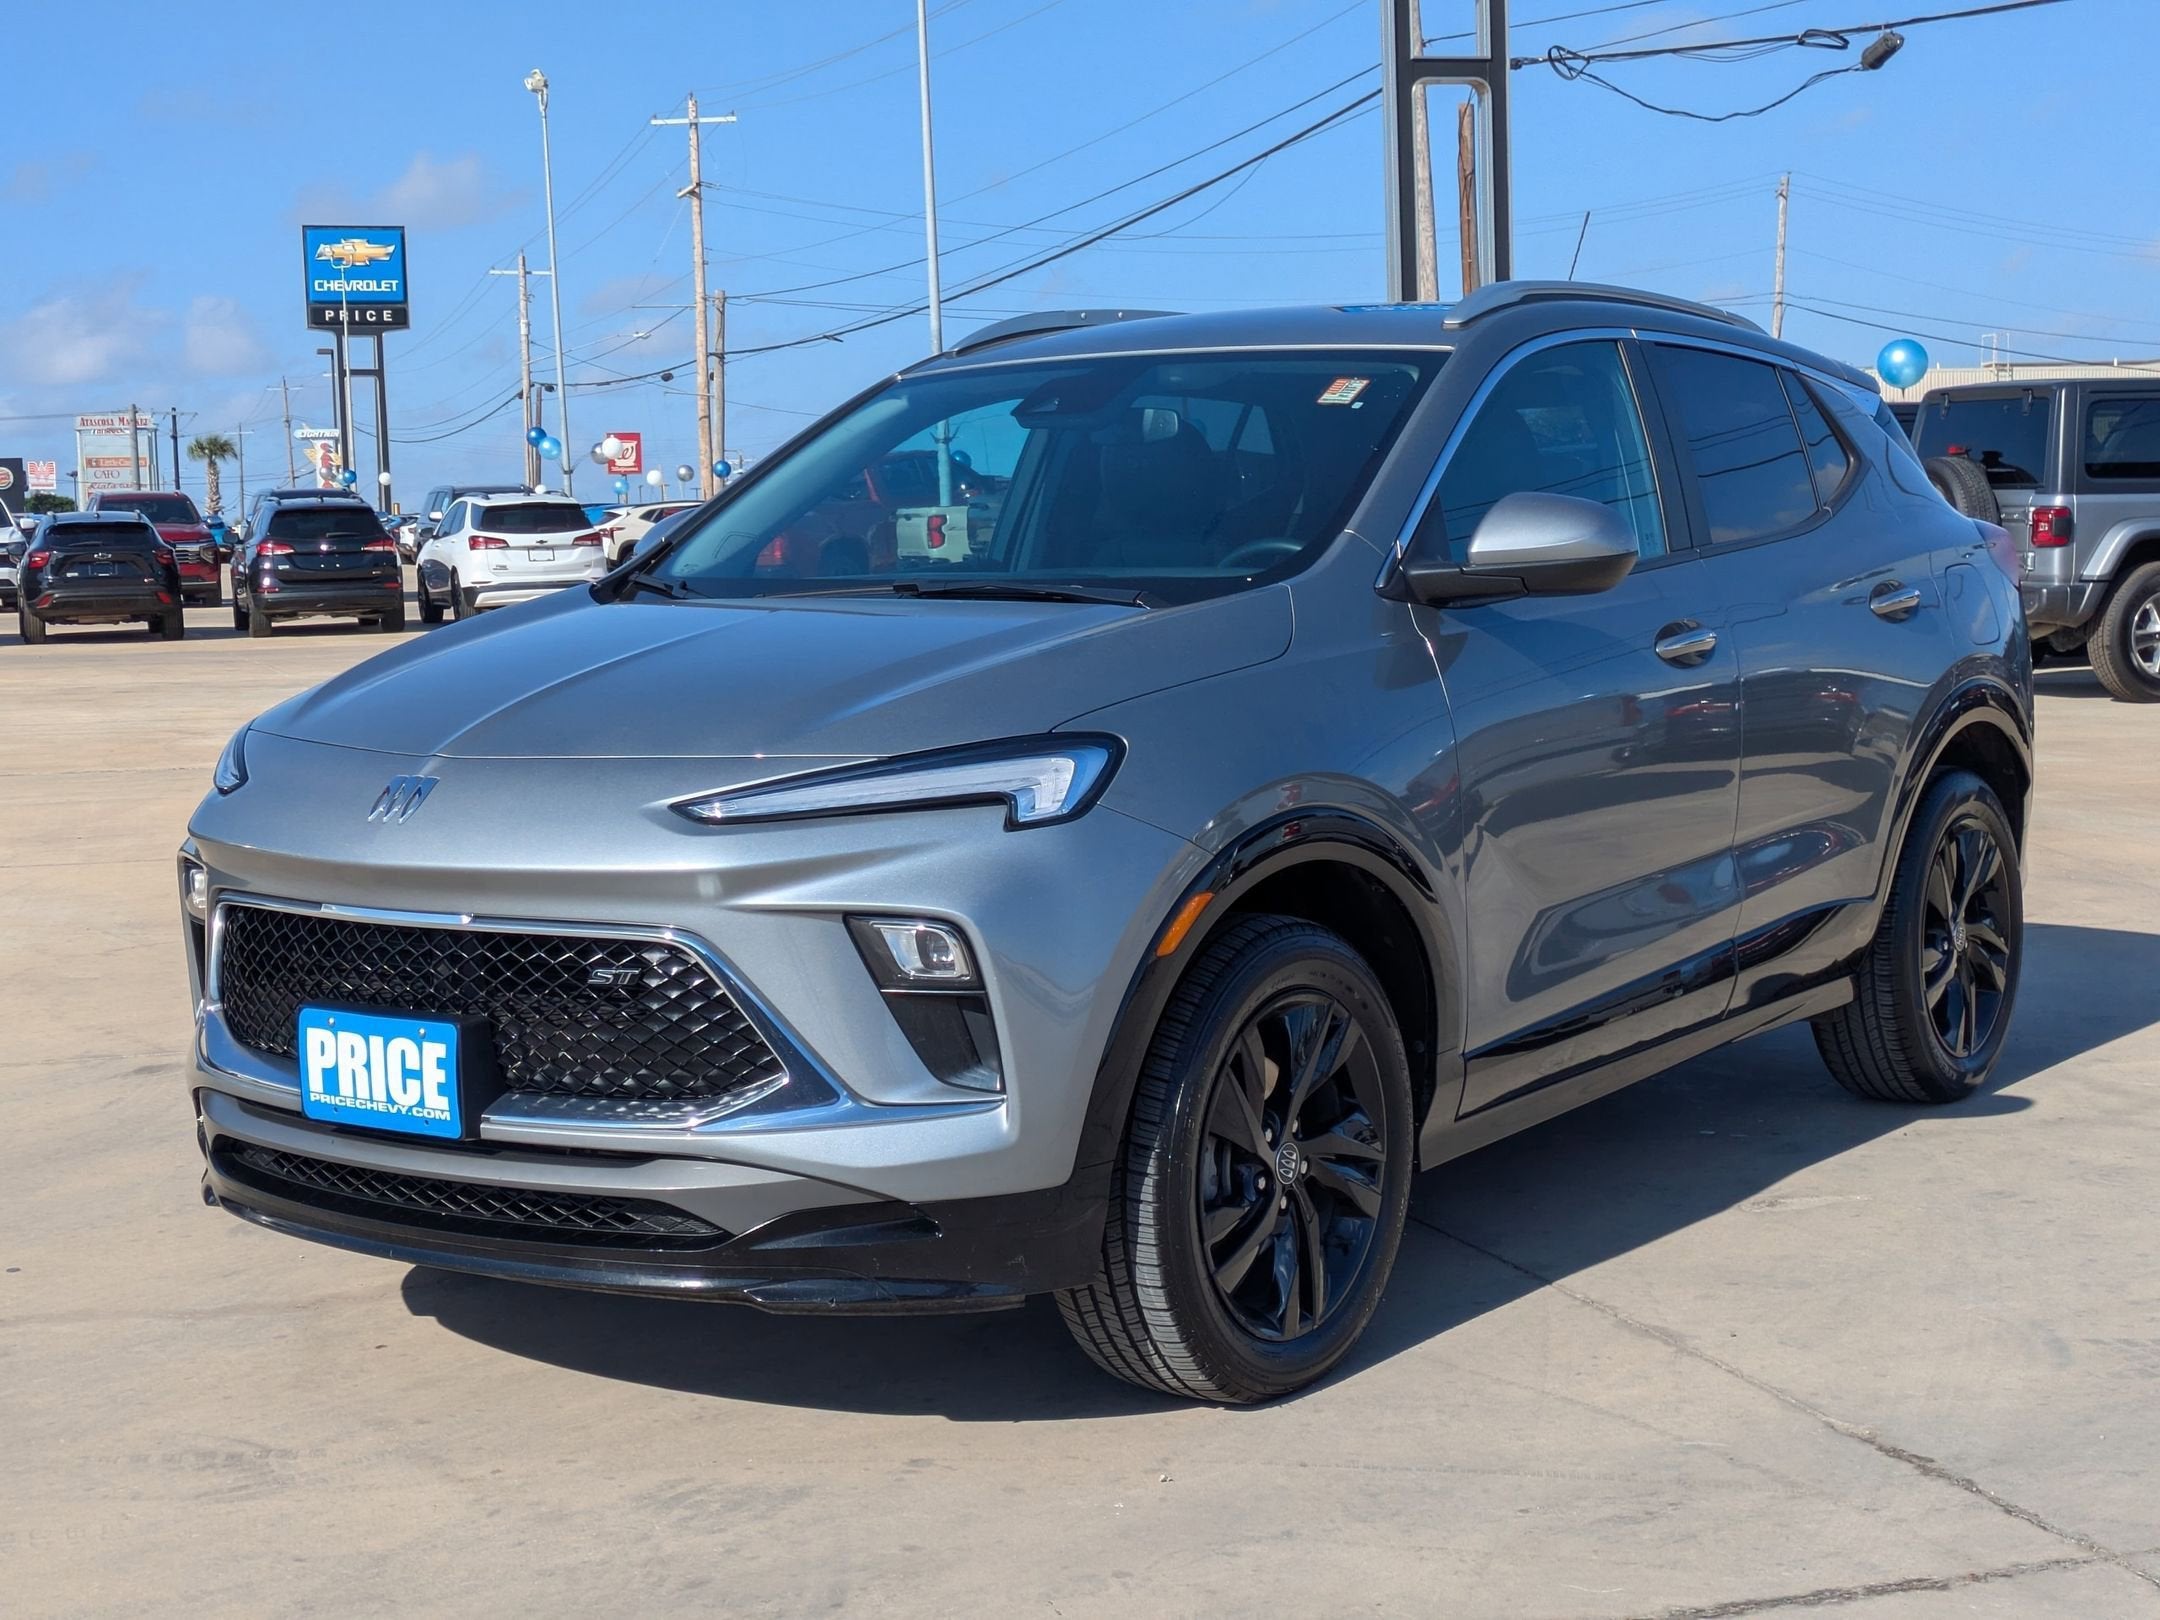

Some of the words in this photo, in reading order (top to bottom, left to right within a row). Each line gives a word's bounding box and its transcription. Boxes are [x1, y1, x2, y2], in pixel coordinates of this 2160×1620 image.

[314, 279, 399, 292] CHEVROLET
[325, 310, 393, 321] PRICE
[587, 968, 641, 984] ST
[306, 1027, 450, 1110] PRICE
[309, 1092, 451, 1121] PRICECHEVY.COM
